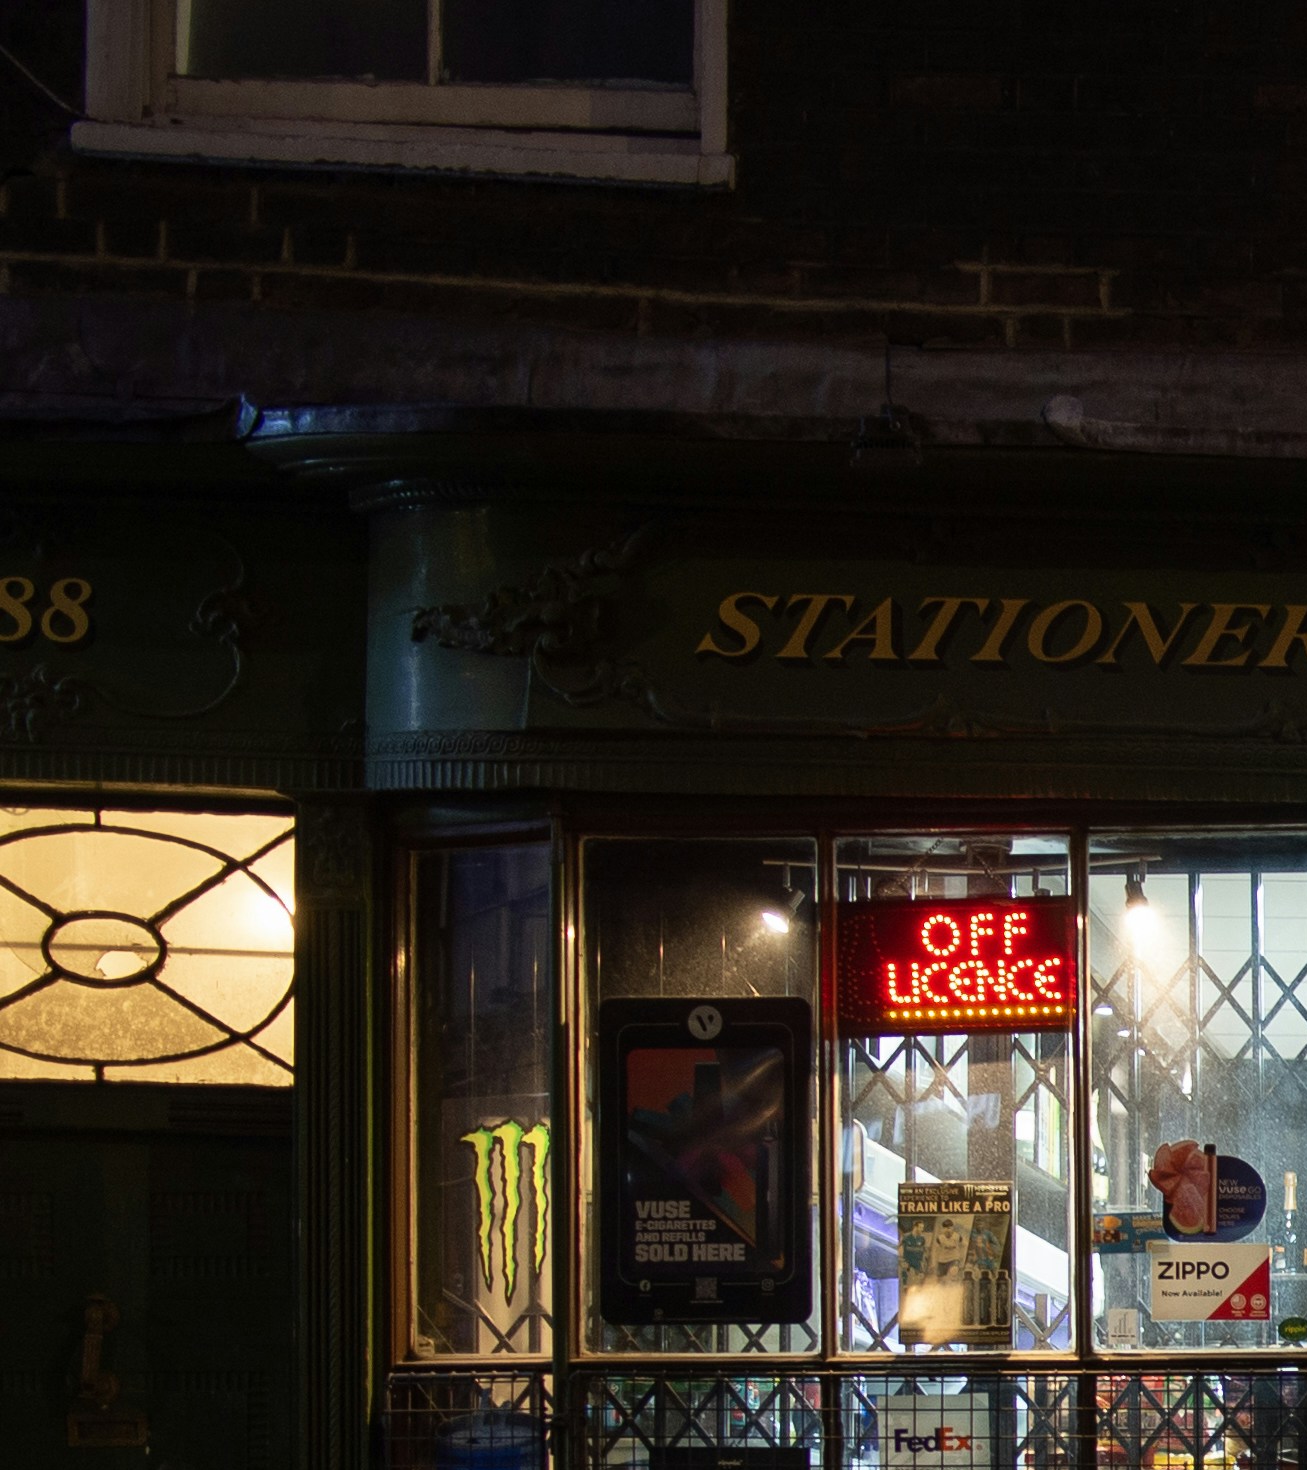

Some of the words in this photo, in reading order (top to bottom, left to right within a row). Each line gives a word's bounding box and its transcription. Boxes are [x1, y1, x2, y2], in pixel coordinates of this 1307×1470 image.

[921, 912, 1028, 956] OFF
[635, 1200, 691, 1219] VUSE
[900, 1201, 938, 1212] TRAIN
[941, 1201, 971, 1212] LIKE
[974, 1201, 983, 1212] A
[985, 1201, 1011, 1212] PRO
[635, 1220, 717, 1231] E-CIGARETTES
[635, 1243, 688, 1262] SOLD
[692, 1243, 747, 1261] HERE
[1157, 1261, 1230, 1280] ZIPPO
[894, 1427, 972, 1453] FedEx
